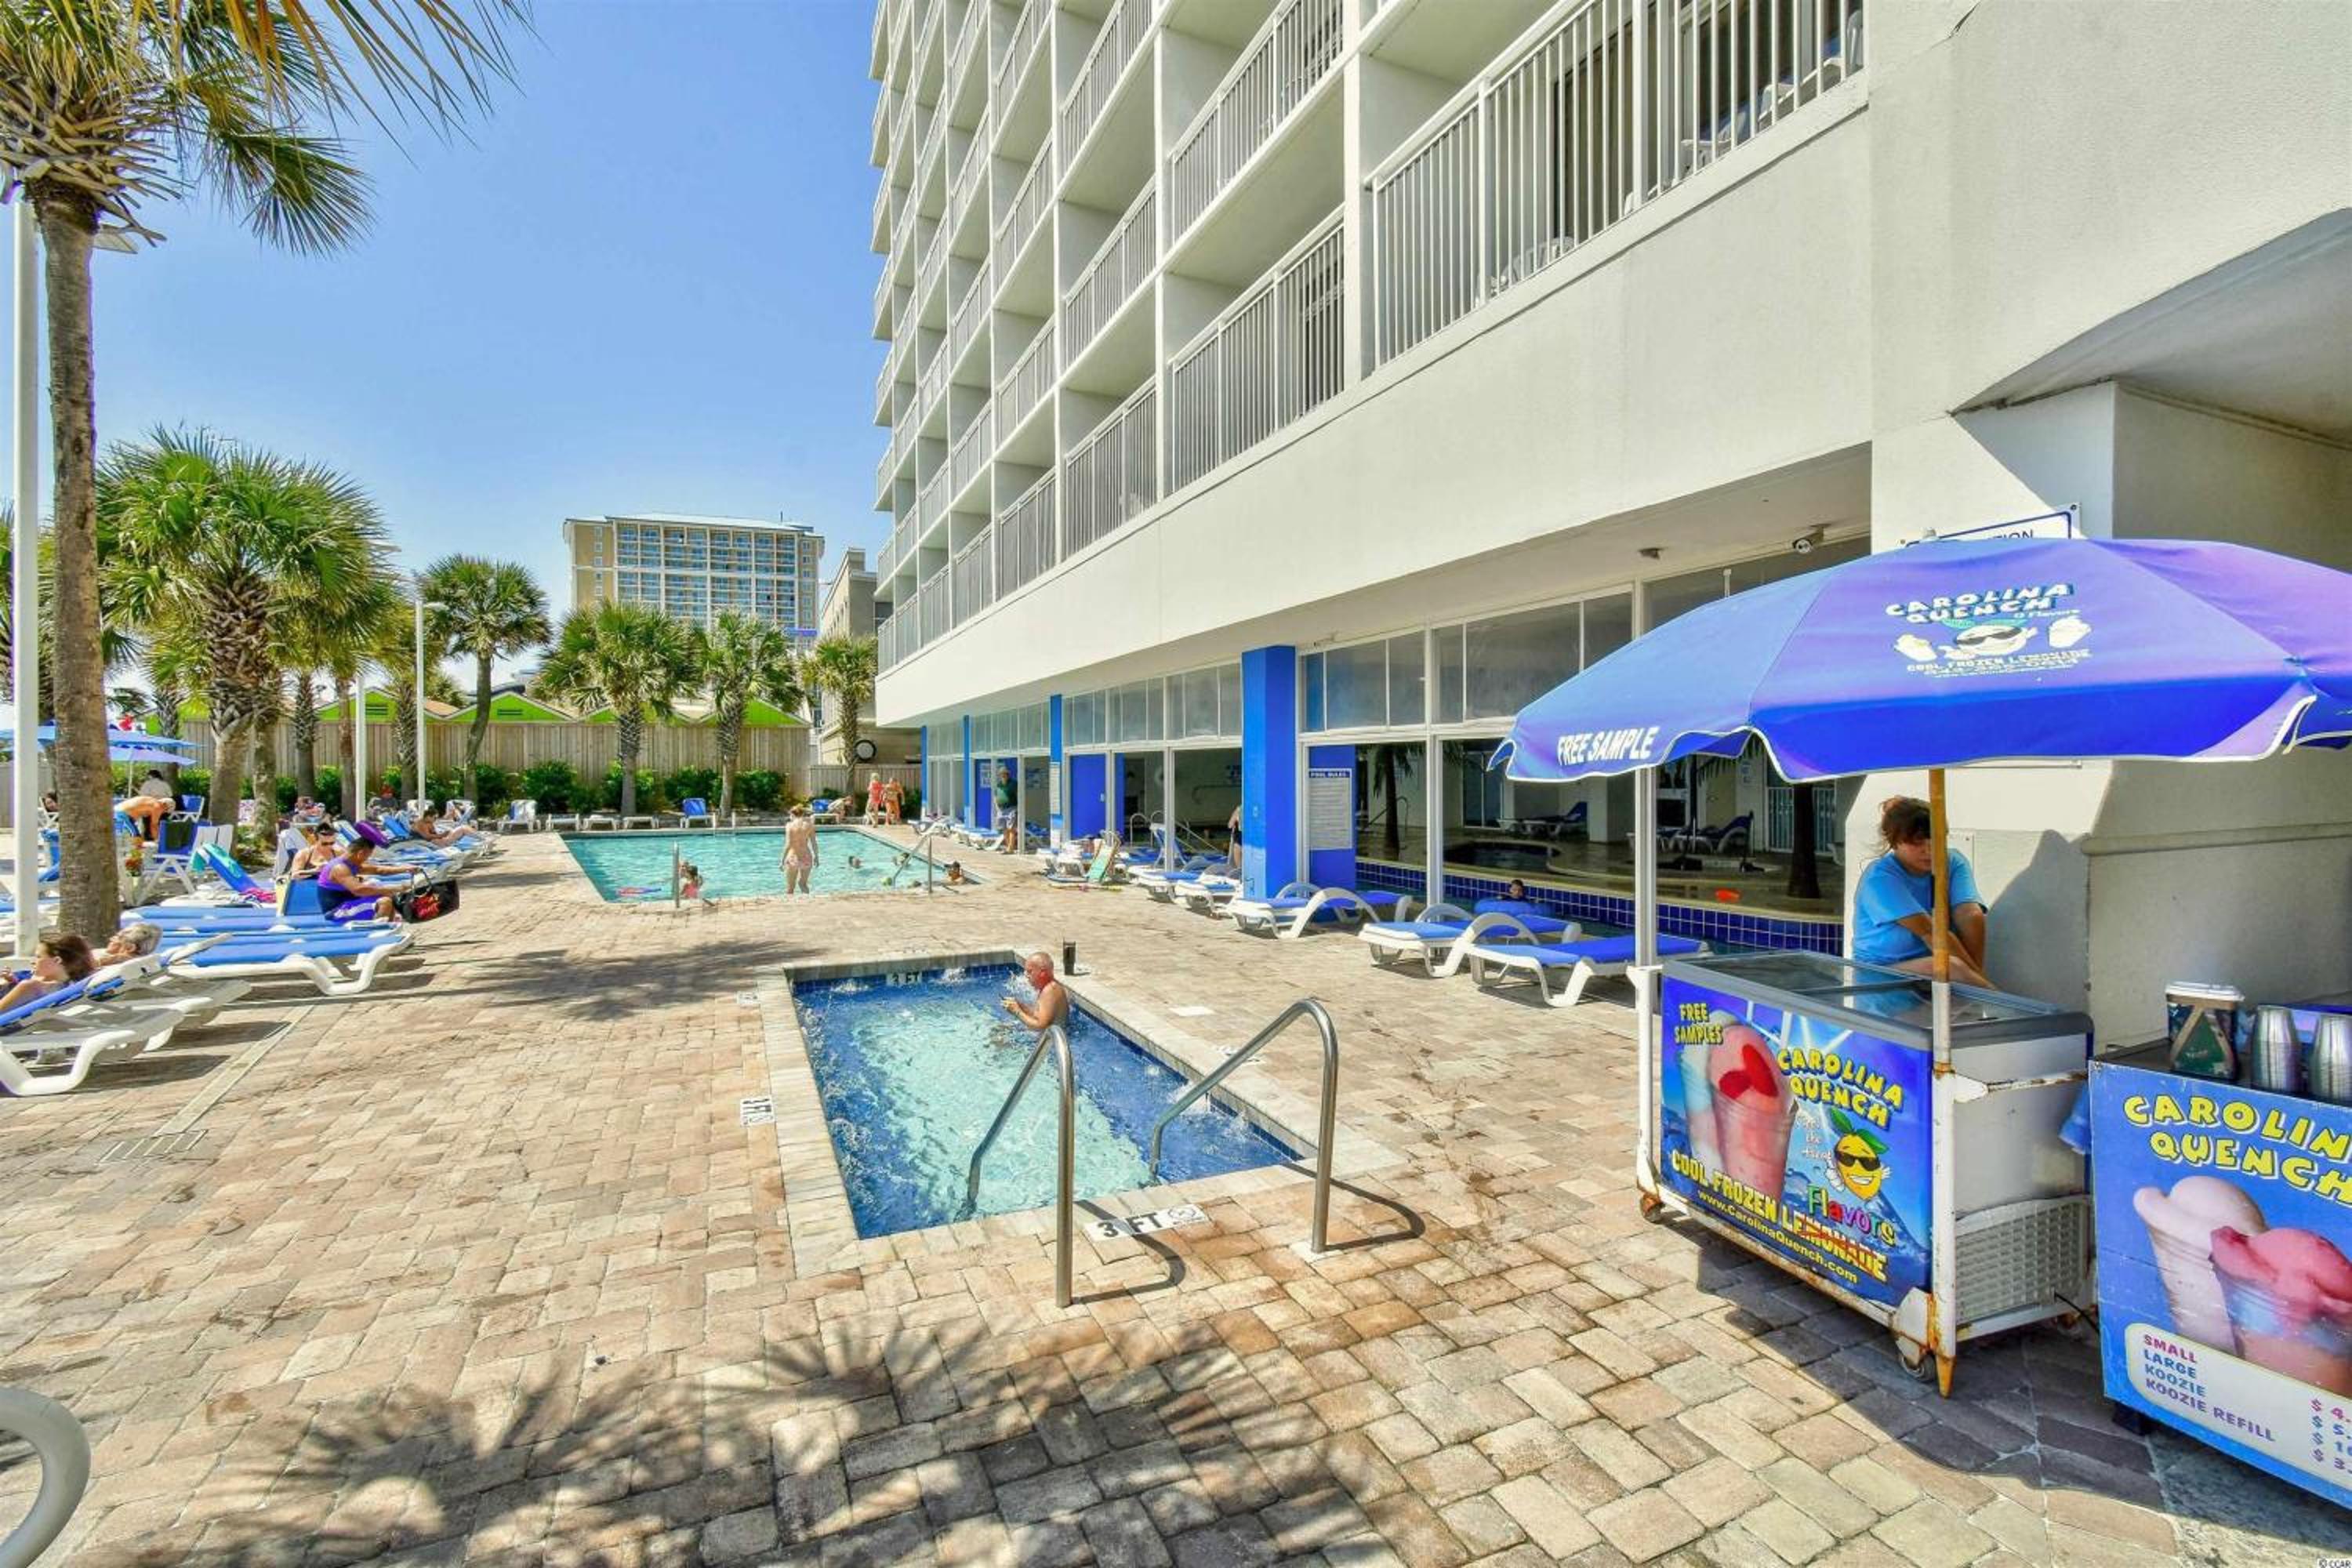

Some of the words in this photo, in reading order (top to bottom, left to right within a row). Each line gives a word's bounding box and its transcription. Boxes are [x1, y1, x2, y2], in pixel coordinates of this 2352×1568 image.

[1885, 583, 2074, 617] CAROLINA
[1906, 597, 2056, 624] QUENCH
[1557, 733, 1592, 765] FREE
[1588, 726, 1660, 762] SAMPLE
[1679, 1003, 1709, 1022] FREE
[1674, 1025, 1724, 1045] SAMPLES
[1777, 1048, 1904, 1113] CAROLINA
[1790, 1076, 1891, 1131] QUENCH
[1672, 1149, 1708, 1188] COOL
[1712, 1168, 1778, 1223] FROZEN
[2150, 1131, 2352, 1207] QUENCH
[1098, 1221, 1119, 1237] 3
[1126, 1212, 1162, 1233] FT
[1808, 1184, 1897, 1247] Flavors
[1697, 1189, 1858, 1284] www.CarolinaQuench.com
[2143, 1334, 2198, 1363] SMALL
[2143, 1348, 2197, 1379] LARGE
[2144, 1363, 2207, 1398] KOOZIE
[2146, 1377, 2208, 1414] KOOZIE
[2213, 1406, 2276, 1443] REFILL
